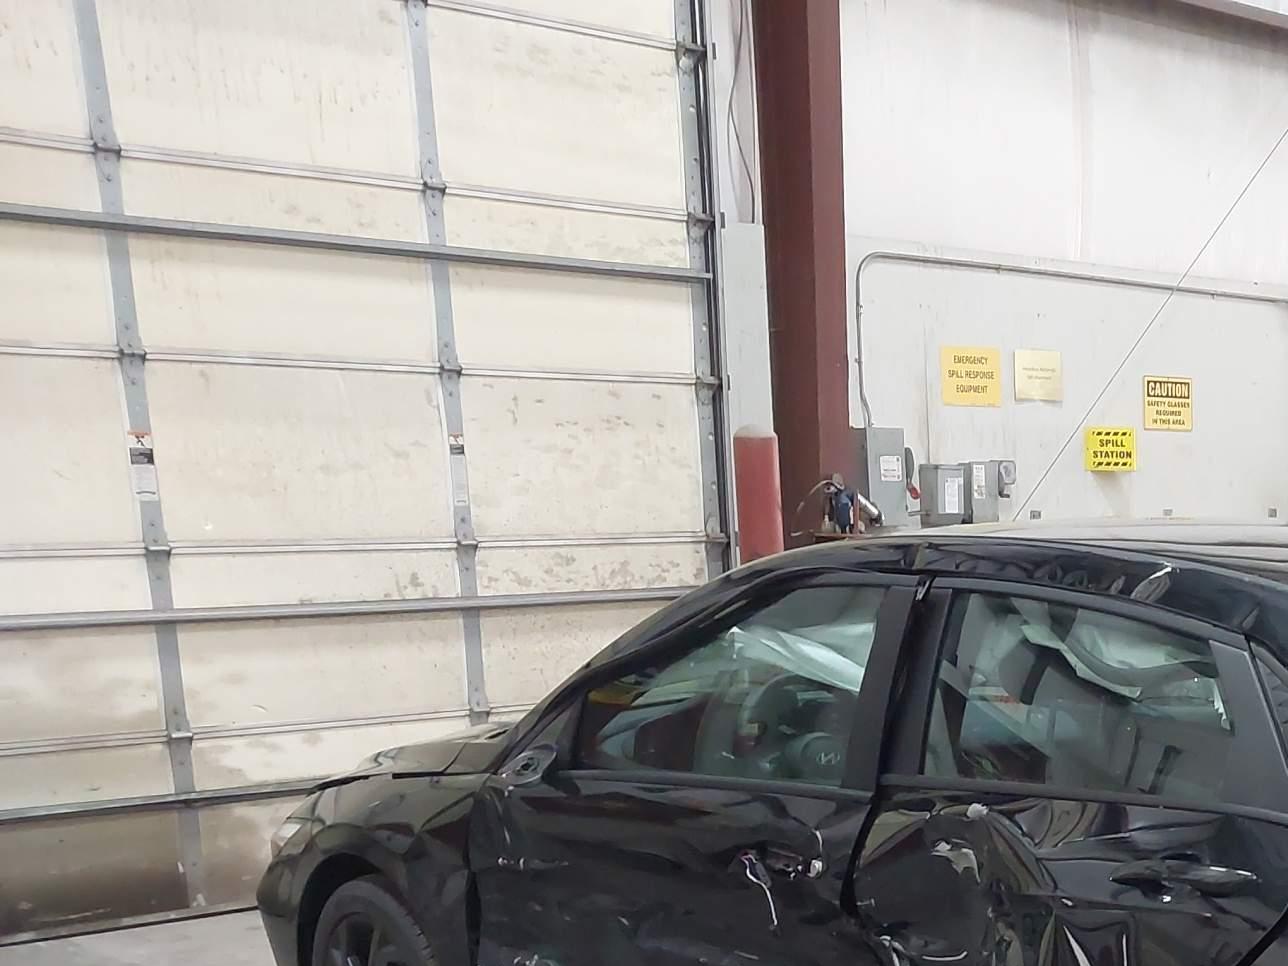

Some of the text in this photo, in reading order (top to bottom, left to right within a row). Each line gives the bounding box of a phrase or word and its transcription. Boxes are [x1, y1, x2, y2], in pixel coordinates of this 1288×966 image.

[954, 355, 988, 365] EMERGENCY
[948, 369, 994, 380] SPILL RESPONSE
[956, 384, 988, 394] EQUIPMENT
[1148, 382, 1188, 398] CAUTION
[1147, 400, 1190, 409] SAFETY GLASSES
[1099, 439, 1126, 448] SPILL
[1093, 451, 1132, 459] STATION
